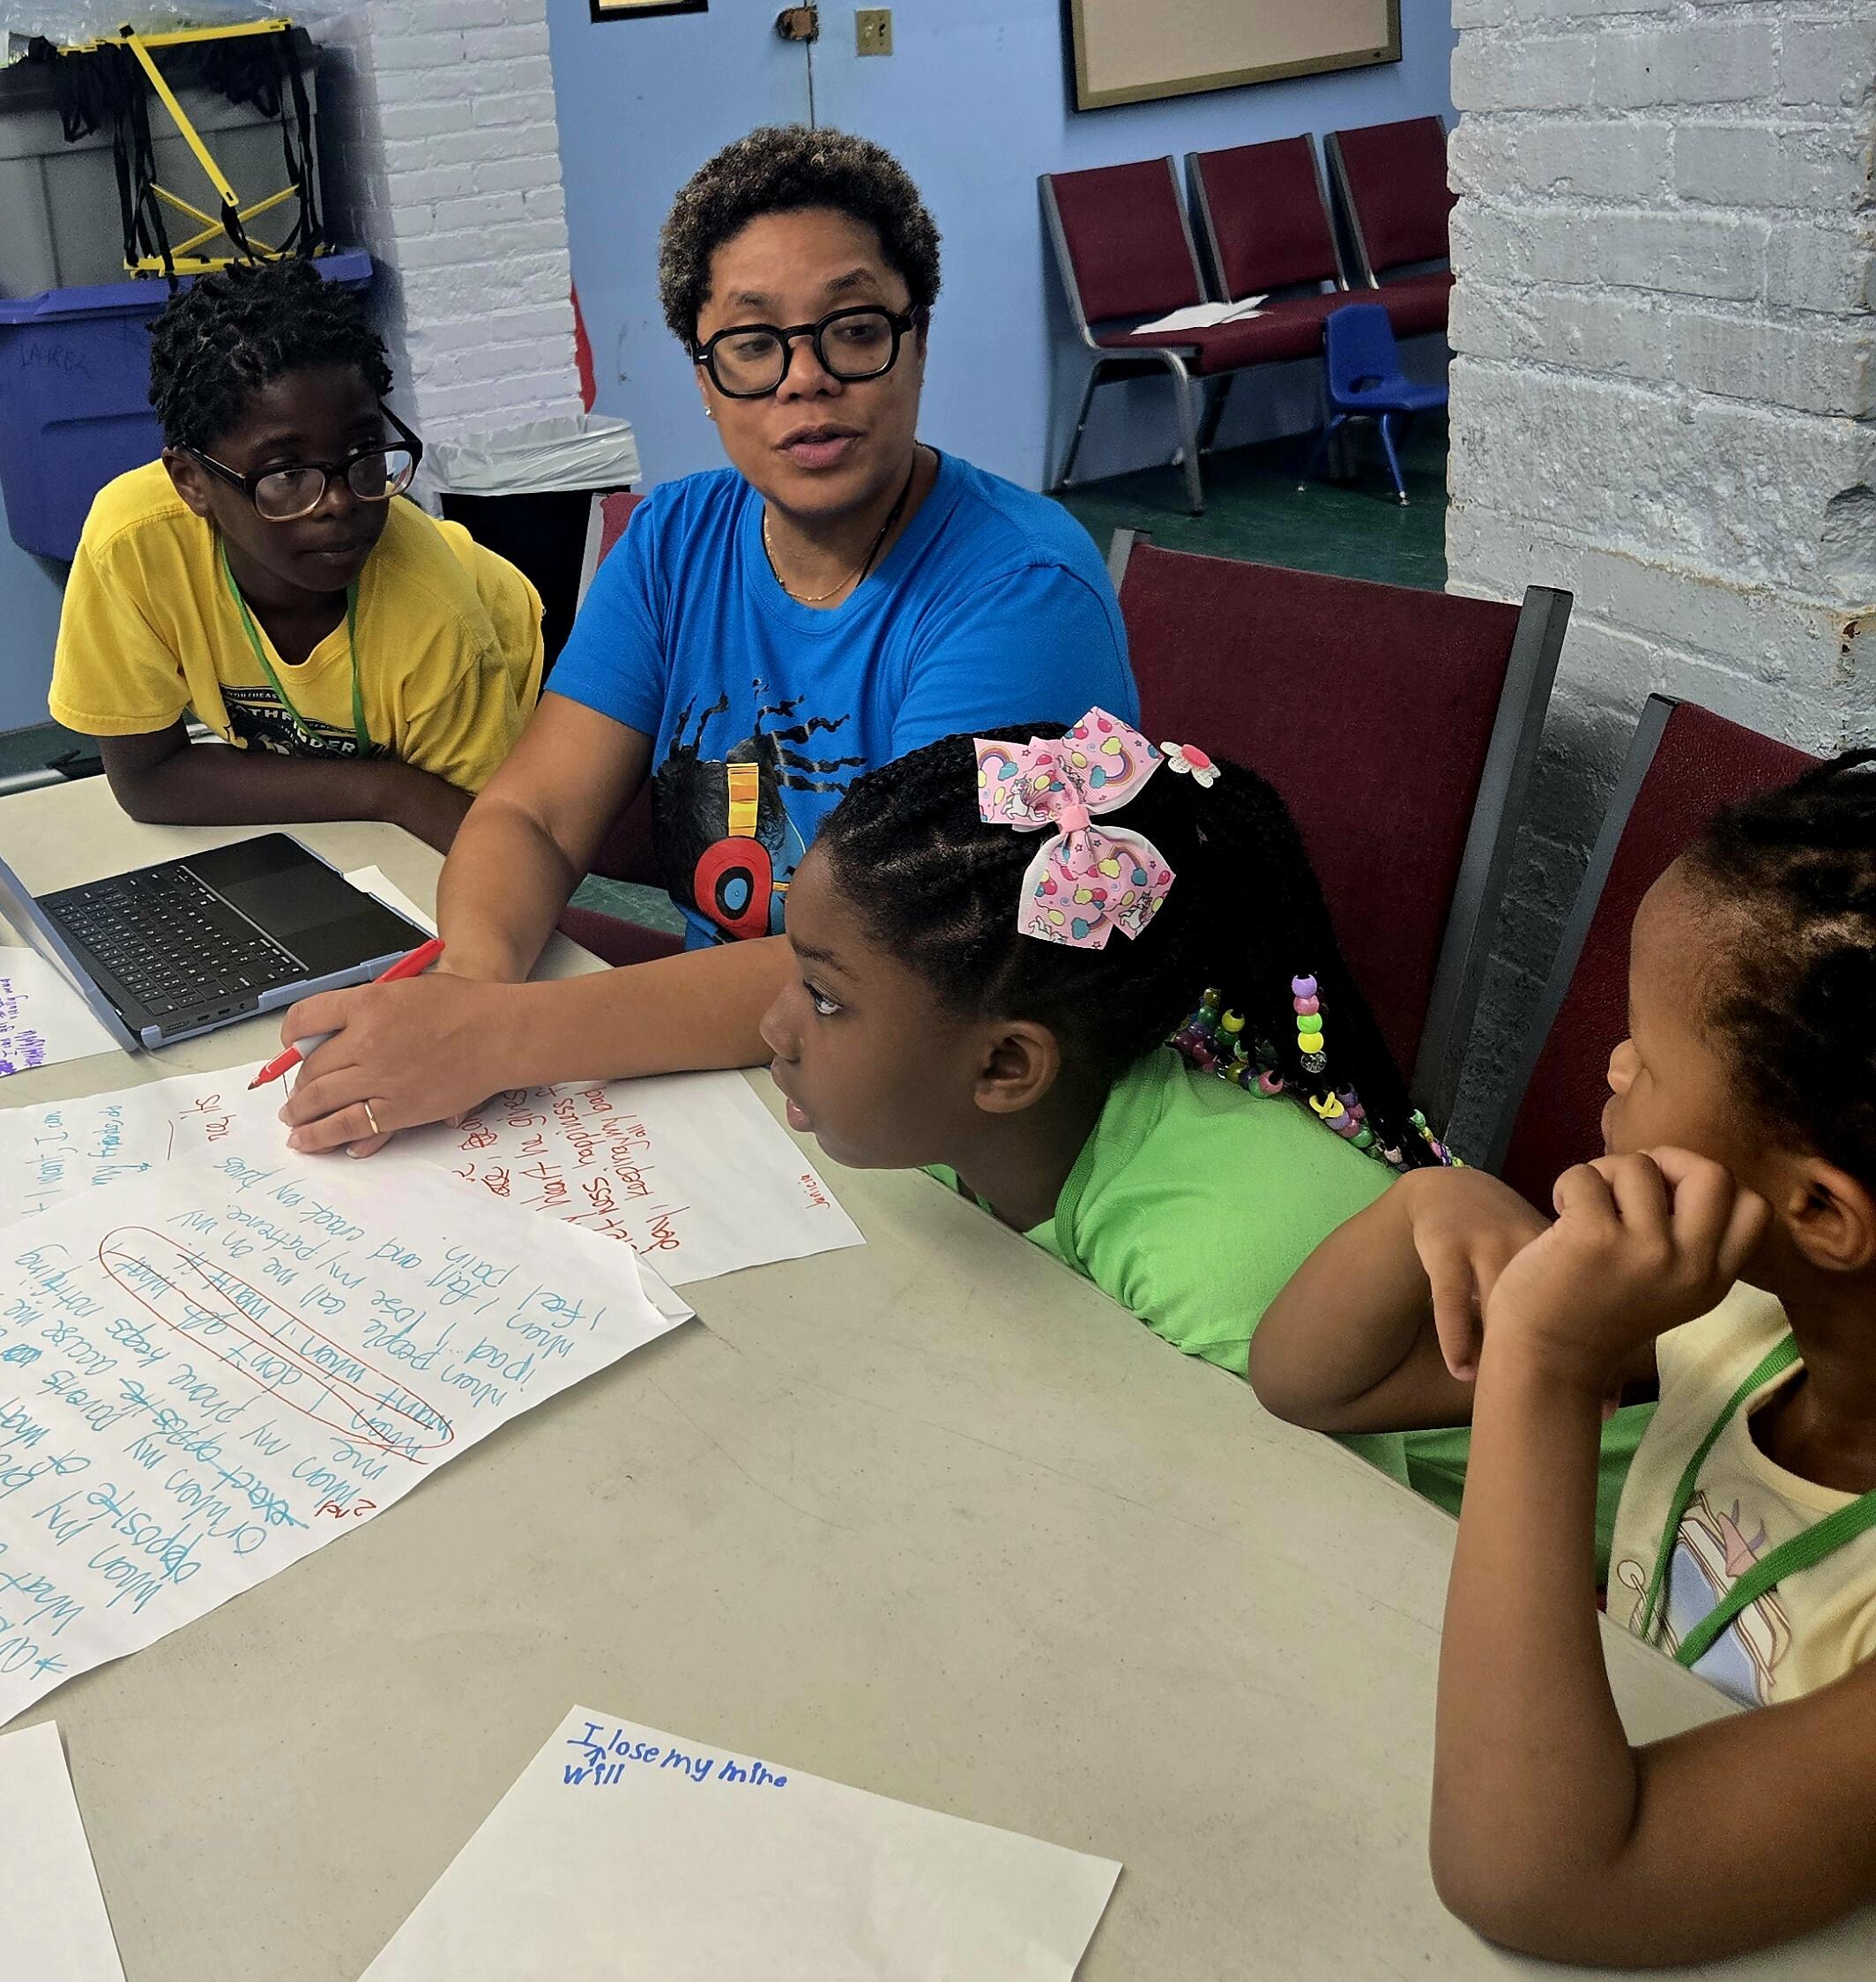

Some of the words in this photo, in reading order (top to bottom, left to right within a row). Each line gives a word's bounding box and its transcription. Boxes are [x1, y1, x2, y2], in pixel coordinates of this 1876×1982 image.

[575, 1087, 614, 1115] bad
[552, 1098, 607, 1170] happiness
[600, 1114, 637, 1138] my
[626, 1123, 646, 1138] all
[602, 1139, 656, 1202] keeping
[221, 1233, 254, 1259] on
[365, 1237, 422, 1270] and
[262, 1256, 300, 1286] me
[316, 1253, 368, 1290] my
[424, 1263, 477, 1306] fall
[3, 1298, 43, 1328] me
[299, 1283, 346, 1315] call
[473, 1297, 501, 1315] I
[517, 1284, 586, 1338] feel
[436, 1322, 458, 1347] I
[589, 1307, 607, 1331] I
[361, 1318, 449, 1371] people
[35, 1369, 132, 1432] parents
[168, 1363, 266, 1424] phone
[309, 1383, 337, 1412] I
[123, 1430, 168, 1470] my
[238, 1419, 292, 1457] my
[24, 1451, 92, 1480] of
[329, 1436, 389, 1480] me
[31, 1489, 94, 1546] my
[566, 1721, 605, 1747] I
[607, 1729, 660, 1763] lose
[660, 1748, 714, 1782] my
[563, 1762, 625, 1785] will
